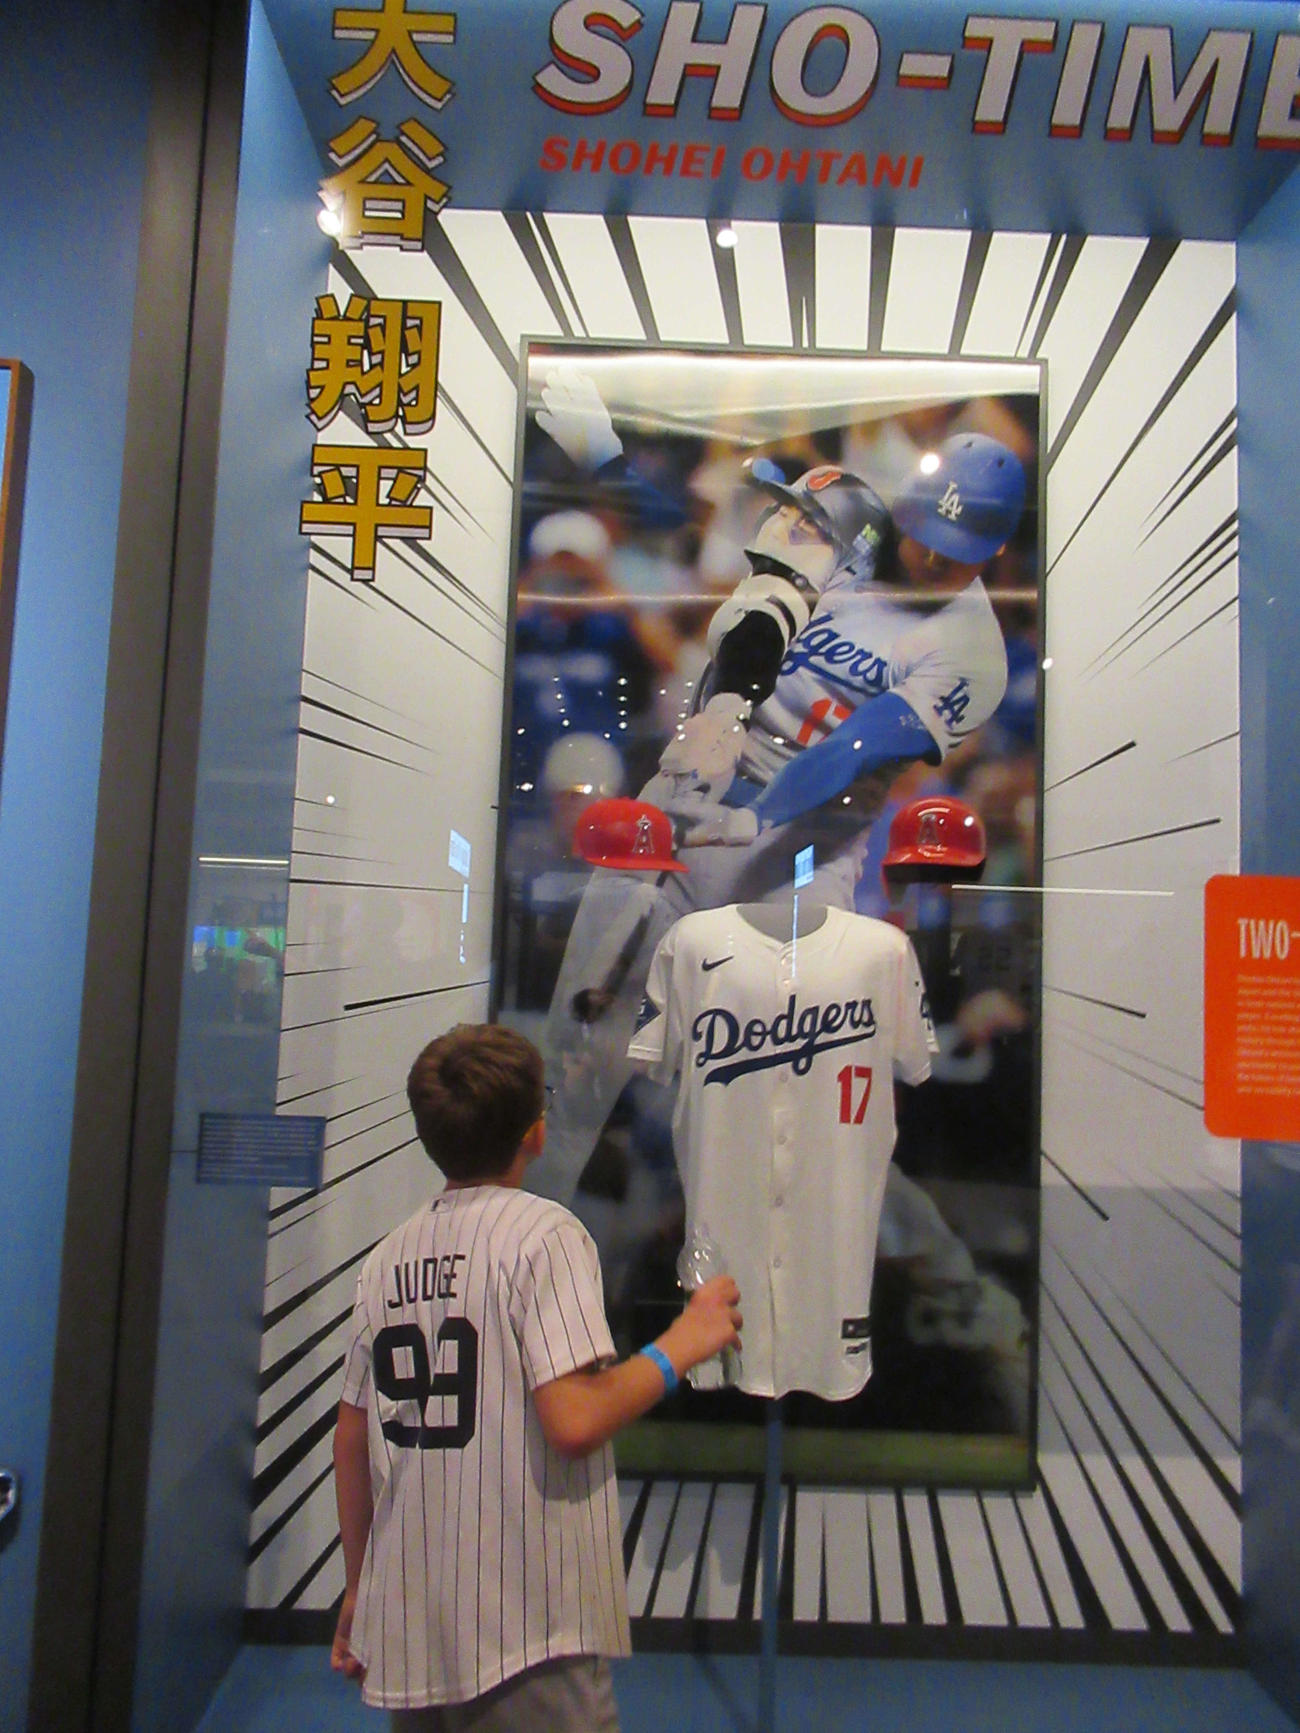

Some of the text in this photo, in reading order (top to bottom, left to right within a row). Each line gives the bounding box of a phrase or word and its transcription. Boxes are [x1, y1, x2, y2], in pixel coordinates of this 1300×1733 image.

[539, 137, 925, 189] SHOHEI OHTANI
[938, 481, 963, 521] LA
[932, 677, 971, 730] LA
[692, 994, 877, 1080] Dodgers
[837, 1065, 873, 1125] 17
[387, 1254, 466, 1309] JUDGE
[372, 1316, 479, 1449] 99
